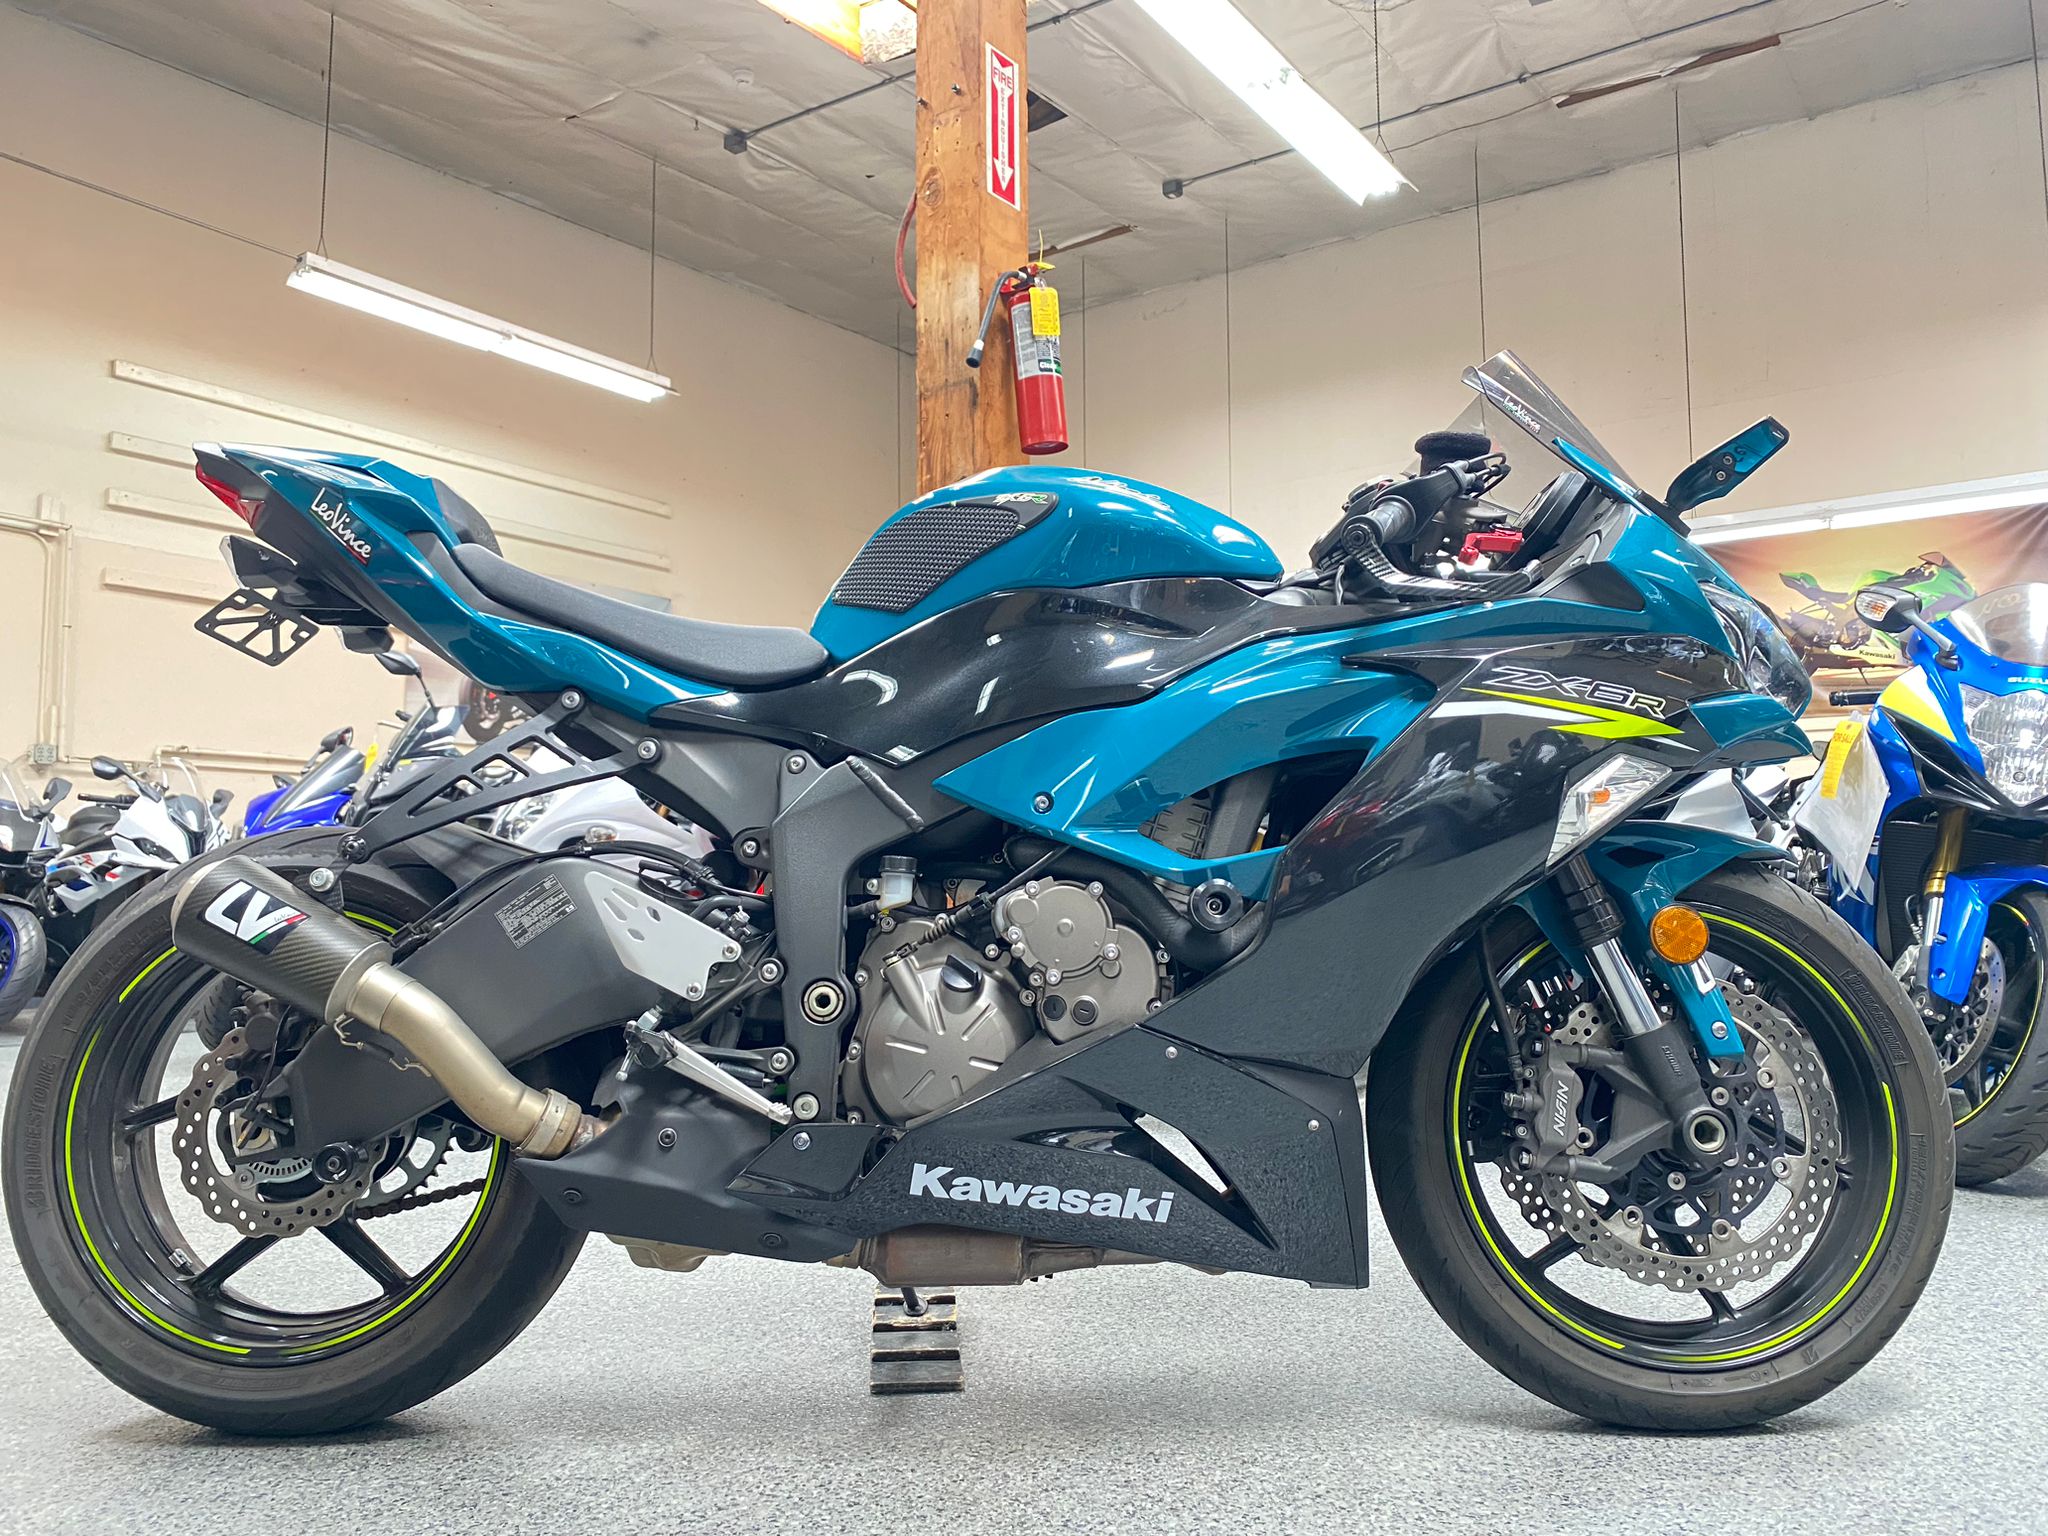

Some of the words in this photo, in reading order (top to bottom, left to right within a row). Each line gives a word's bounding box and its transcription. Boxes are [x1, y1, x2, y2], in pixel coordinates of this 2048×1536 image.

[993, 67, 1013, 90] FIRE
[310, 487, 372, 558] LeoVince
[1859, 650, 1896, 660] Kawasaki
[1482, 666, 1666, 719] ZX-6R
[204, 880, 303, 942] LV
[24, 1058, 56, 1208] BRIDGESTONE
[1553, 1079, 1569, 1136] NISSIN
[909, 1162, 1175, 1224] Kawasaki
